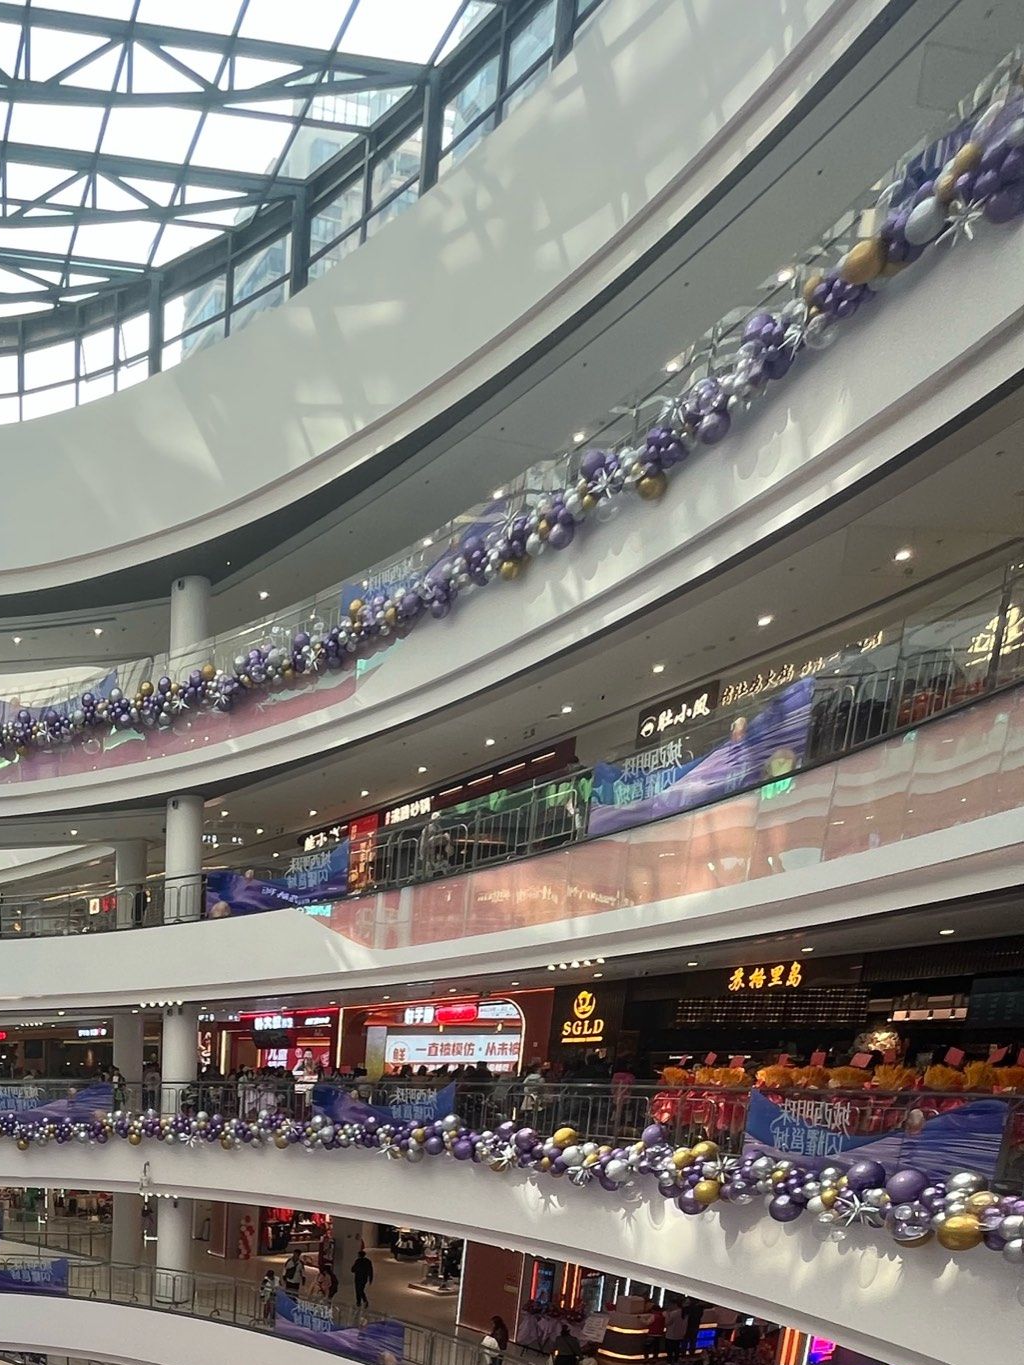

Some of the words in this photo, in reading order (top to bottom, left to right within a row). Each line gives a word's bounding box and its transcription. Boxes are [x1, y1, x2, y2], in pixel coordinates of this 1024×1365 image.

[728, 961, 802, 992] 苏格里岛
[561, 1018, 604, 1036] SGLD
